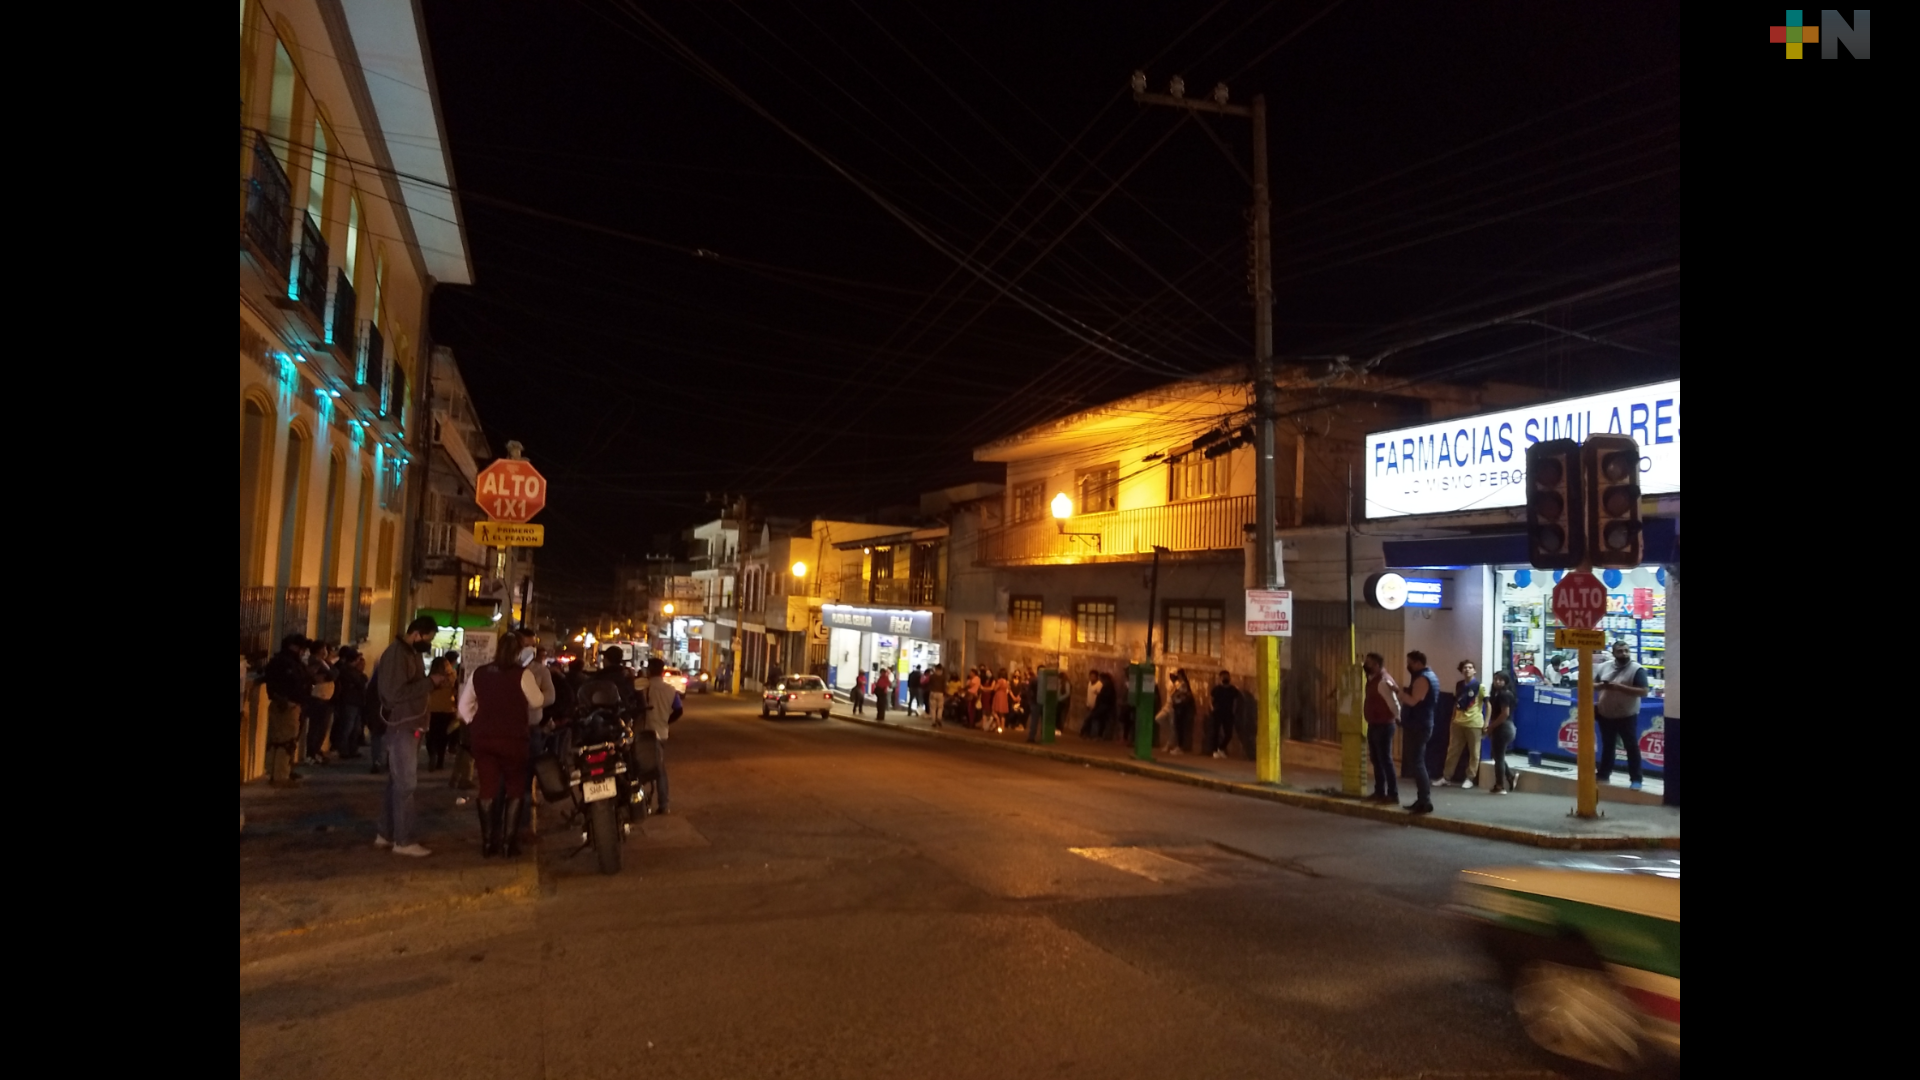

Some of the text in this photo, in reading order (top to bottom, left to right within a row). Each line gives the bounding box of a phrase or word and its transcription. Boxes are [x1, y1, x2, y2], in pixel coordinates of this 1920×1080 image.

[1375, 398, 1680, 477] FARMACIAS SIMIARE
[482, 472, 540, 499] ALTO
[1479, 469, 1523, 487] PERO
[493, 498, 527, 518] 1X1
[497, 526, 535, 535] PRIMERO
[1557, 587, 1603, 608] ALTO
[1264, 610, 1286, 620] auto
[1565, 610, 1593, 628] 1X1
